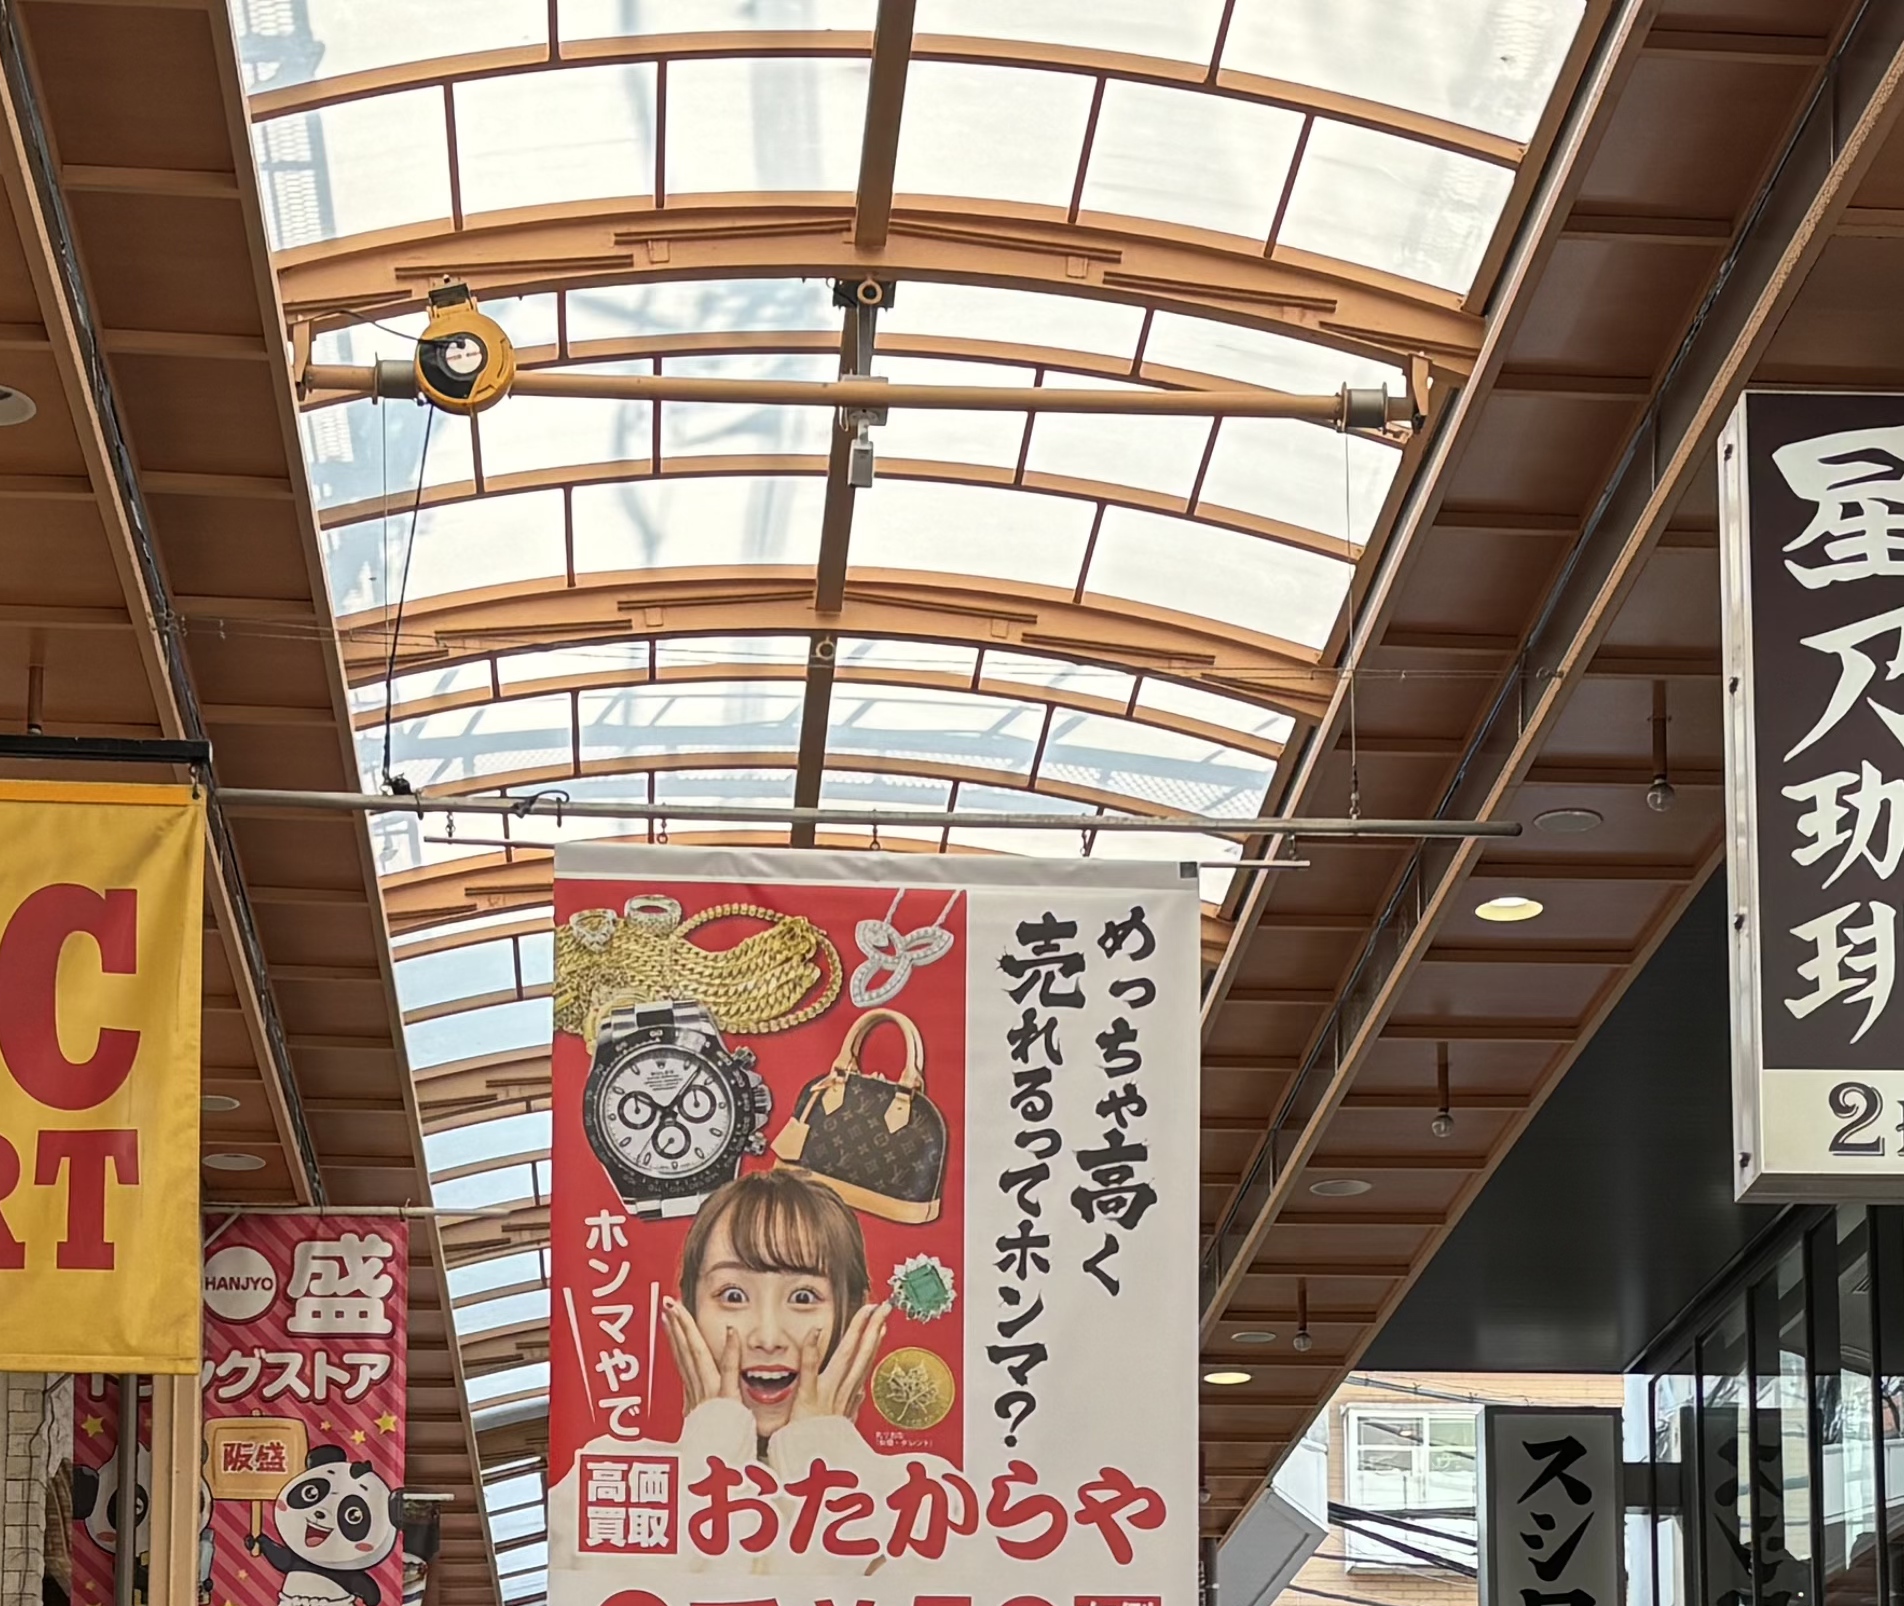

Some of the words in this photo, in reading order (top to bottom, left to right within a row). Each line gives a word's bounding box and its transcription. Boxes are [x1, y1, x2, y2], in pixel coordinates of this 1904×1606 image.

[1070, 904, 1159, 1299] めっちゃ高く
[203, 1274, 275, 1292] HANJYO
[288, 1232, 394, 1336] 盛
[582, 1208, 645, 1441] ホンマやで
[222, 1440, 287, 1474] 阪盛
[585, 1461, 670, 1506] 高価
[585, 1506, 670, 1549] 買取
[686, 1455, 1169, 1567] おたからや
